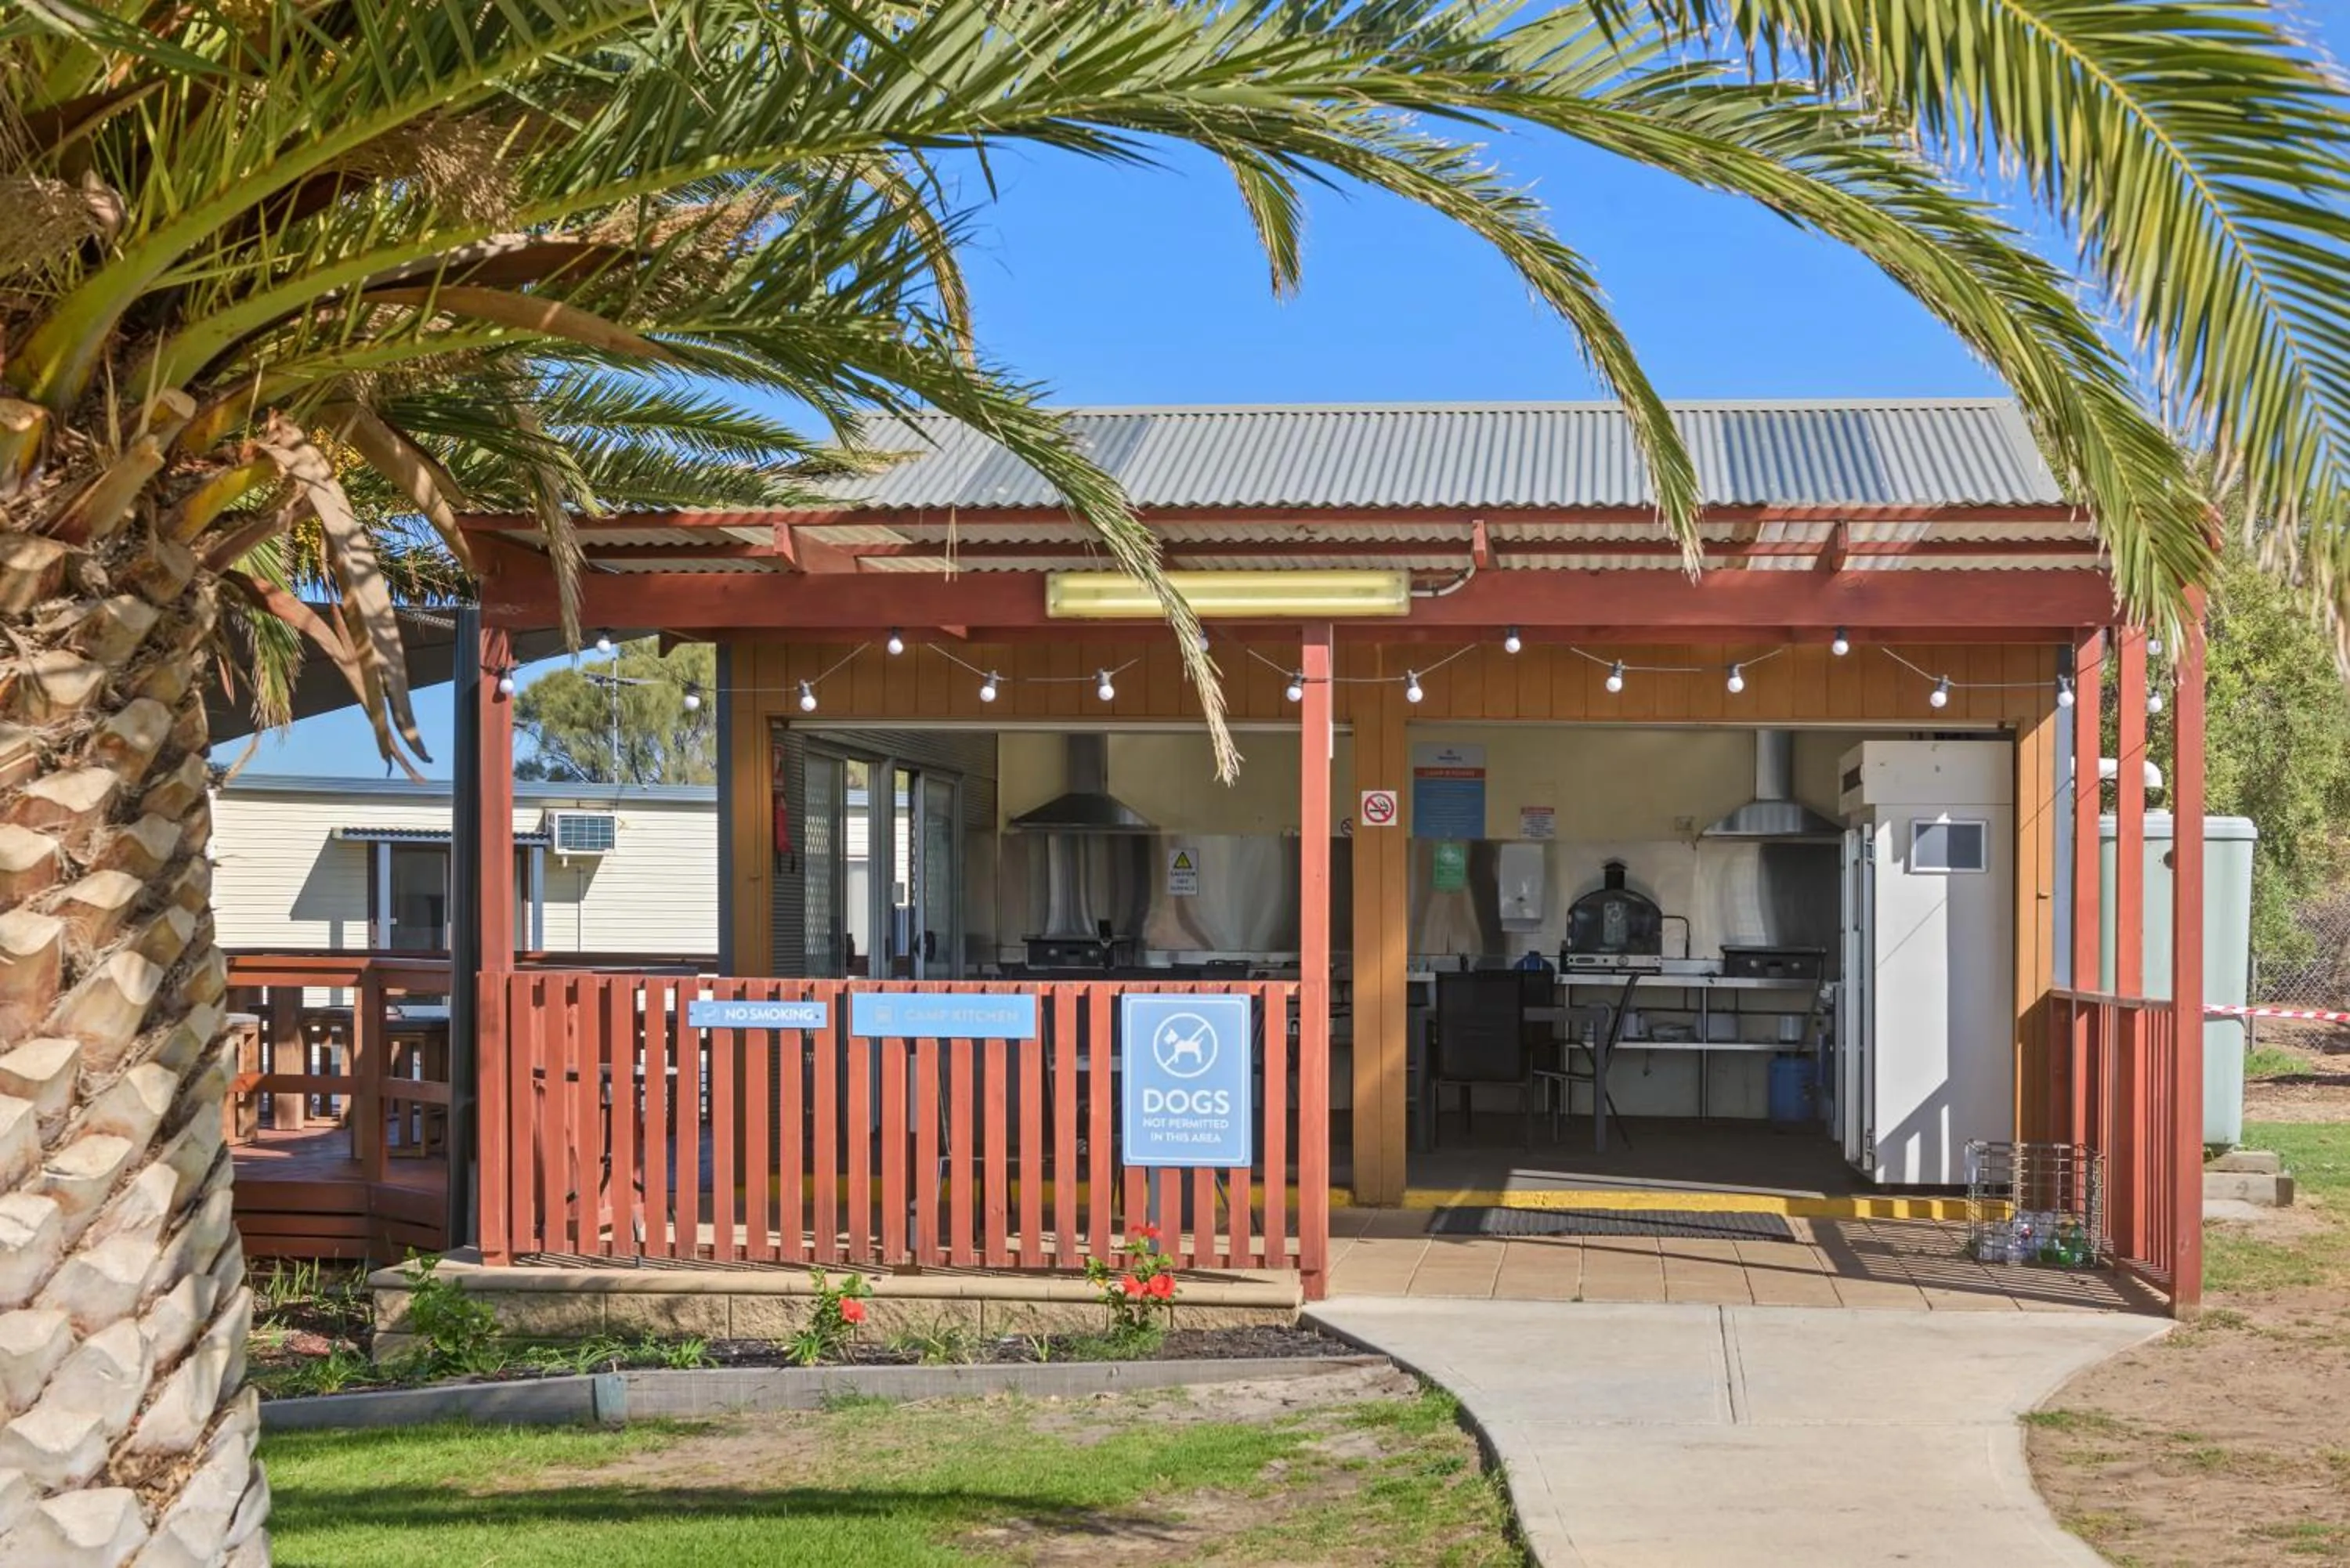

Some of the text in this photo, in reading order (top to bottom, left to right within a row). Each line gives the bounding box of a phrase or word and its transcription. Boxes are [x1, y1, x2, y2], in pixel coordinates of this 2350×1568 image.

[724, 1007, 813, 1021] NO SMOKING
[903, 1008, 1020, 1023] CAMP KITCHEN
[1143, 1088, 1231, 1115] DOGS
[1142, 1117, 1229, 1129] NOT PERMITTED
[1150, 1132, 1222, 1143] IN THIS AREA
